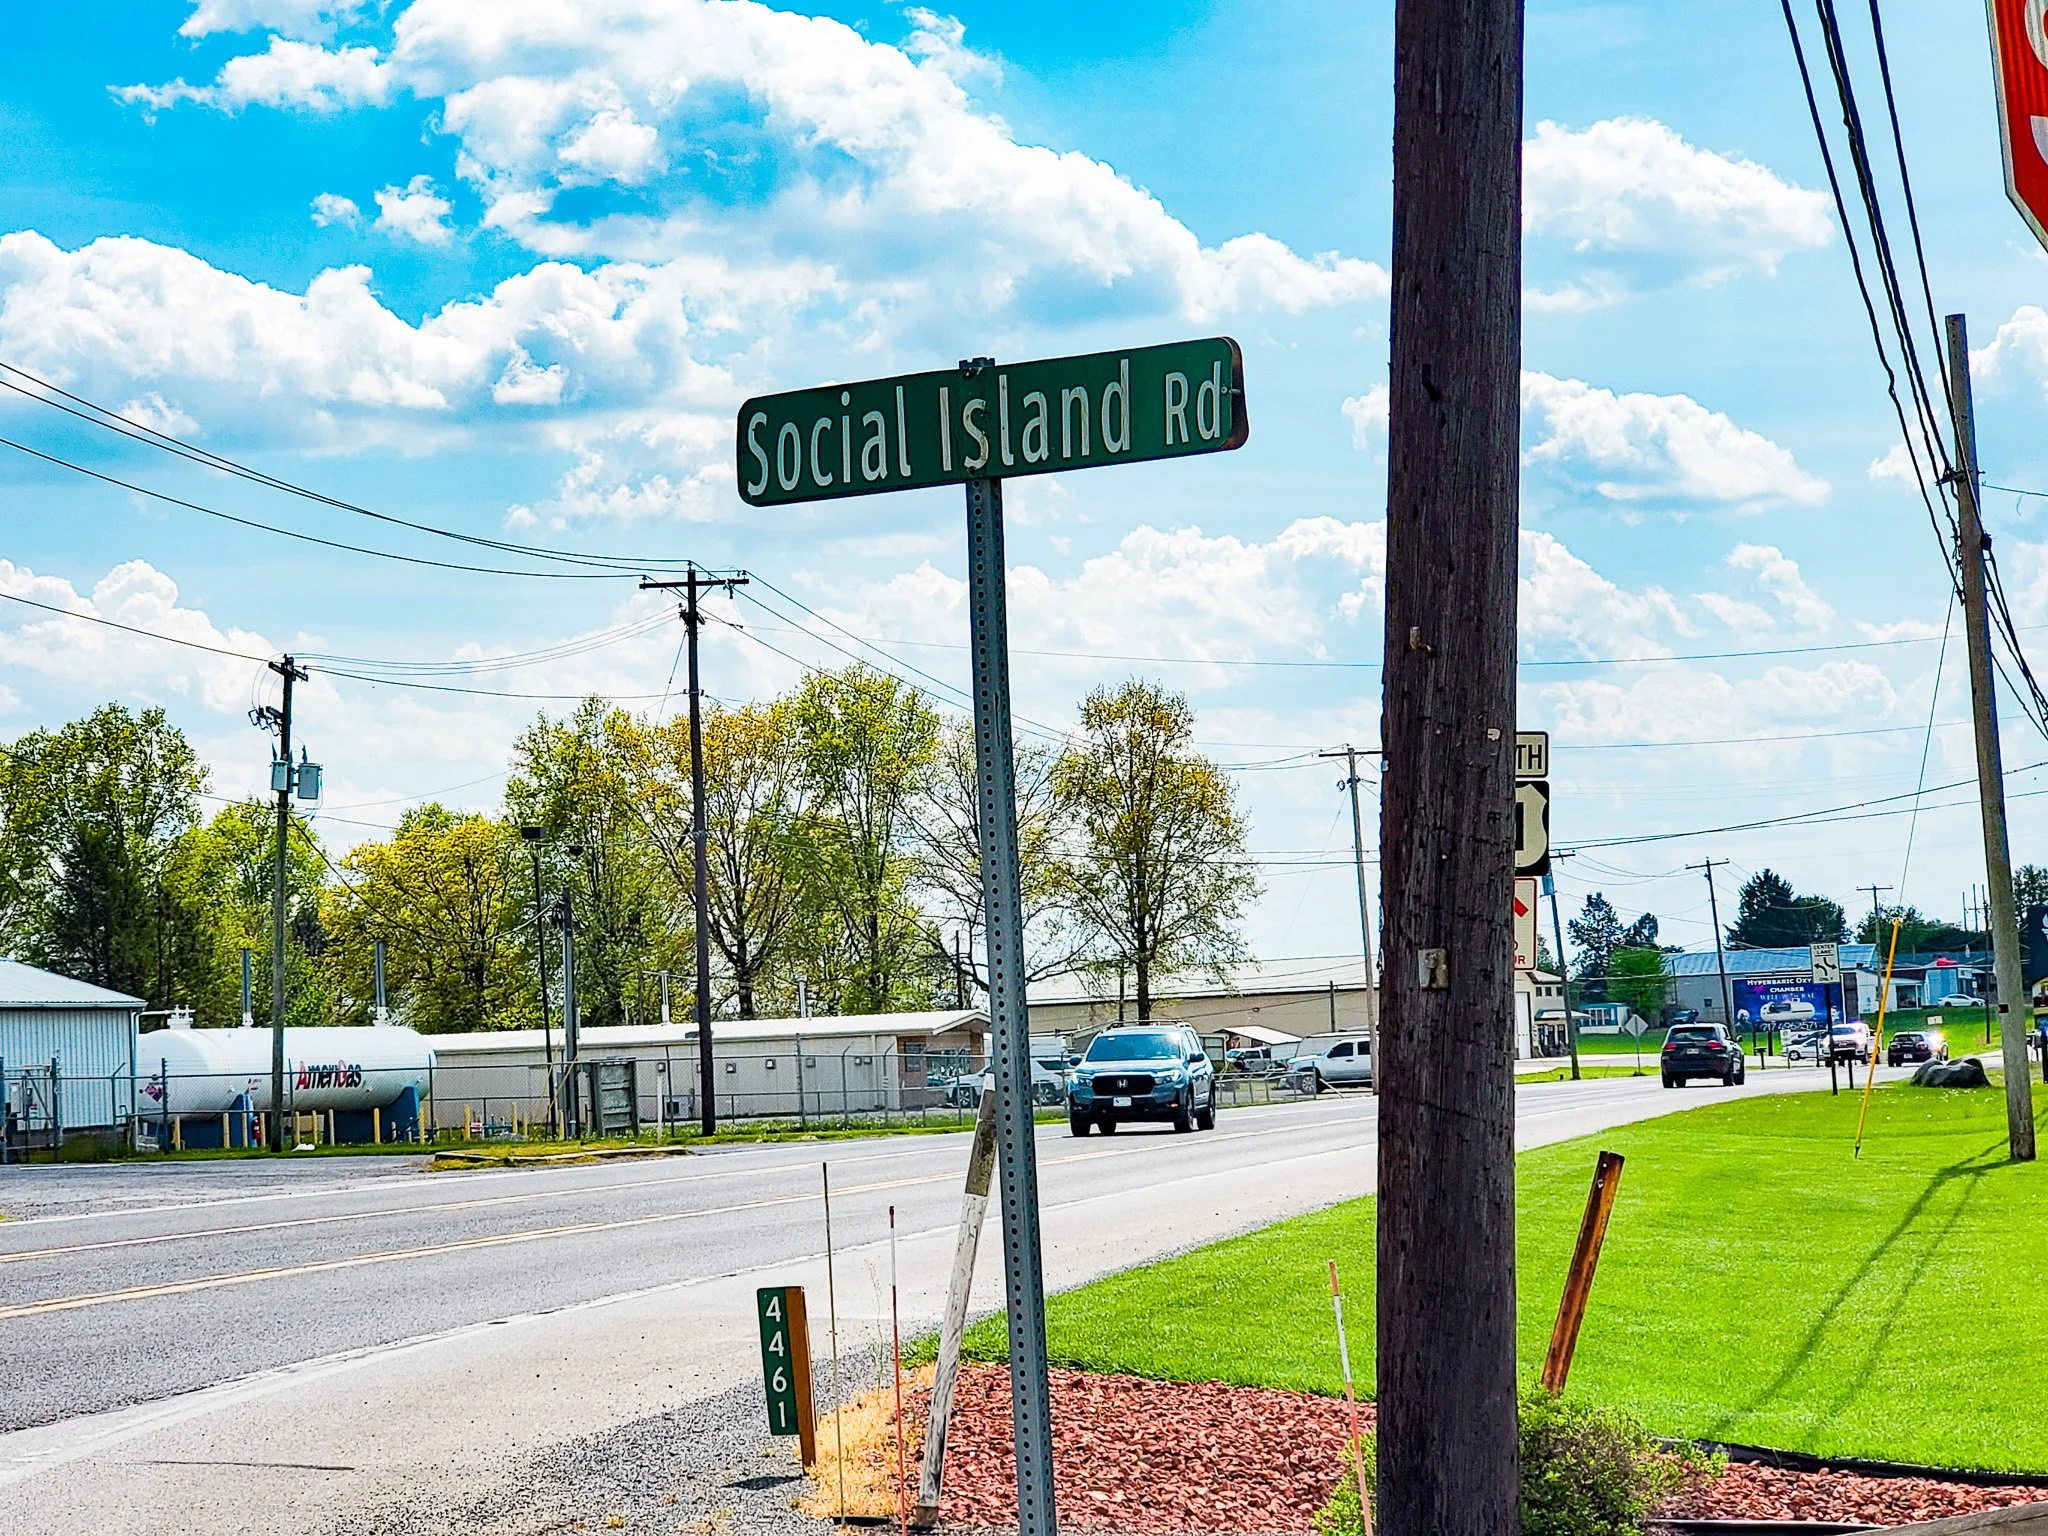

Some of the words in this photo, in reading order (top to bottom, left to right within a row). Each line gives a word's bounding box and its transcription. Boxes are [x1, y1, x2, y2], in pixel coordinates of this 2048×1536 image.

[747, 385, 912, 497] Social
[939, 359, 1131, 472] Island
[1165, 361, 1222, 447] Rd
[295, 1059, 362, 1091] AmeriGas
[765, 1296, 788, 1428] 4461
